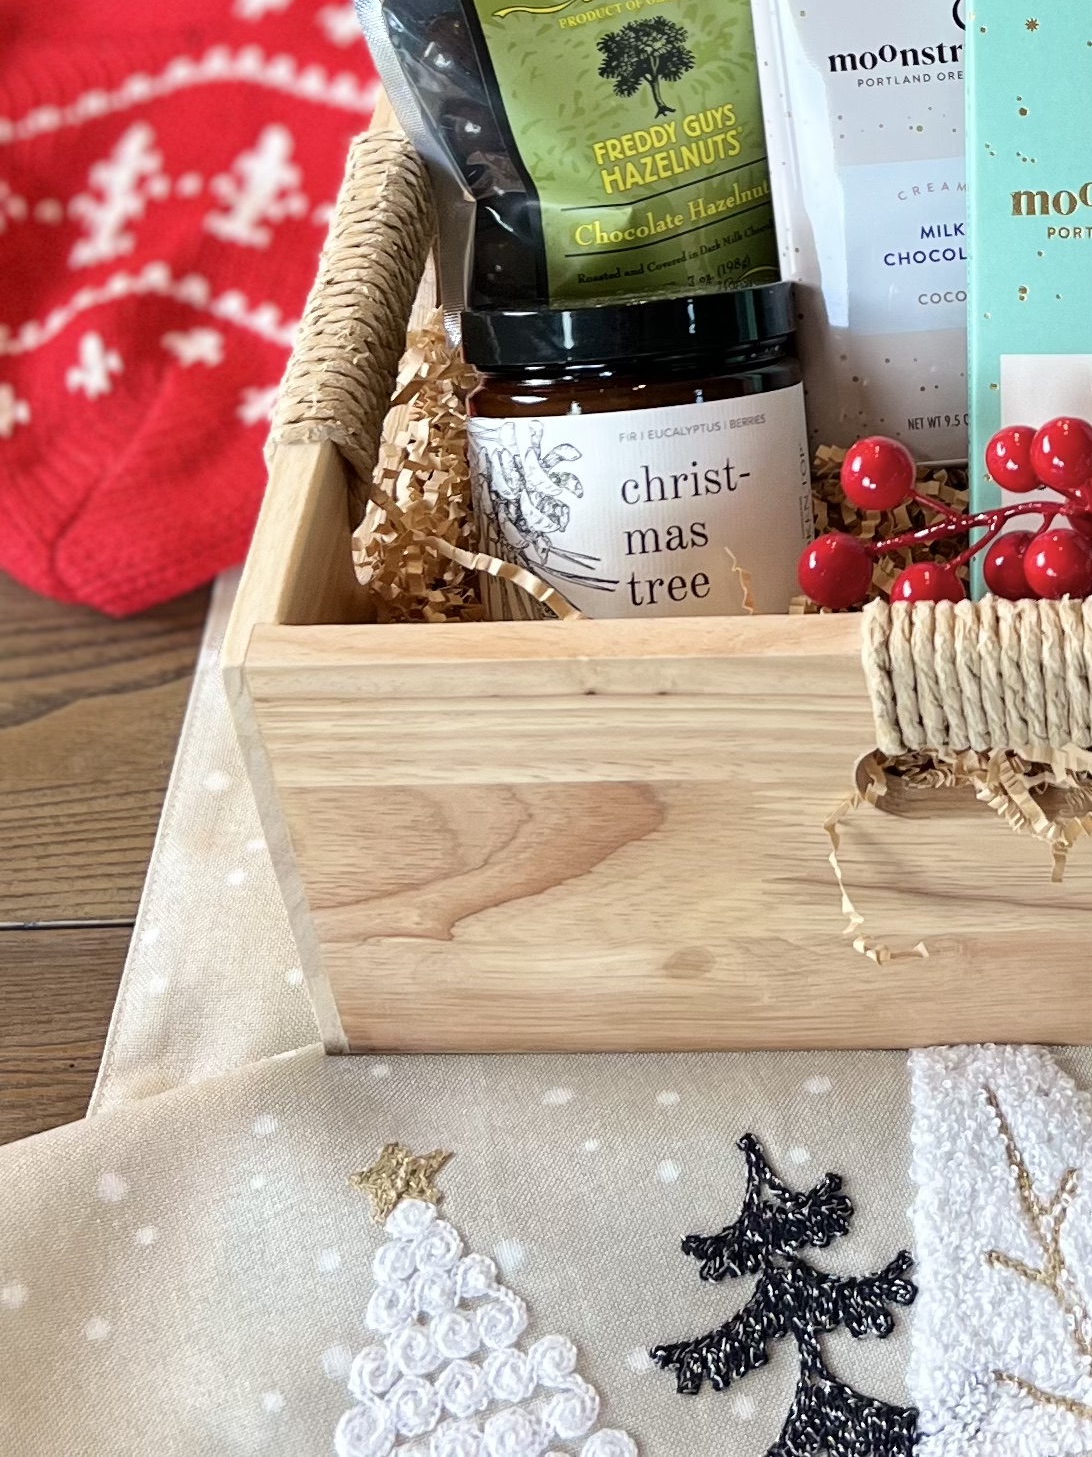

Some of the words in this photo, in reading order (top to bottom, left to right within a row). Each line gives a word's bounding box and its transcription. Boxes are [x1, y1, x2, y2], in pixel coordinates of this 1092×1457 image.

[558, 3, 622, 29] PRODUCT
[857, 73, 931, 88] PORTLAND
[937, 70, 965, 82] ORE
[592, 120, 677, 165] FREDDY
[682, 103, 736, 137] GUYS
[600, 129, 742, 194] HAZELNUTS
[574, 212, 685, 247] Chocolate
[920, 222, 965, 239] MILK
[577, 268, 622, 284] Roasted
[624, 263, 645, 277] and
[647, 251, 687, 273] Covered
[619, 431, 637, 443] FIR
[647, 421, 721, 440] EUCALYPTUS
[729, 414, 766, 429] BERRIES
[908, 417, 924, 431] NET
[927, 415, 941, 429] WT
[621, 457, 751, 505] christ-
[624, 521, 709, 556] mas
[626, 571, 711, 607] tree
